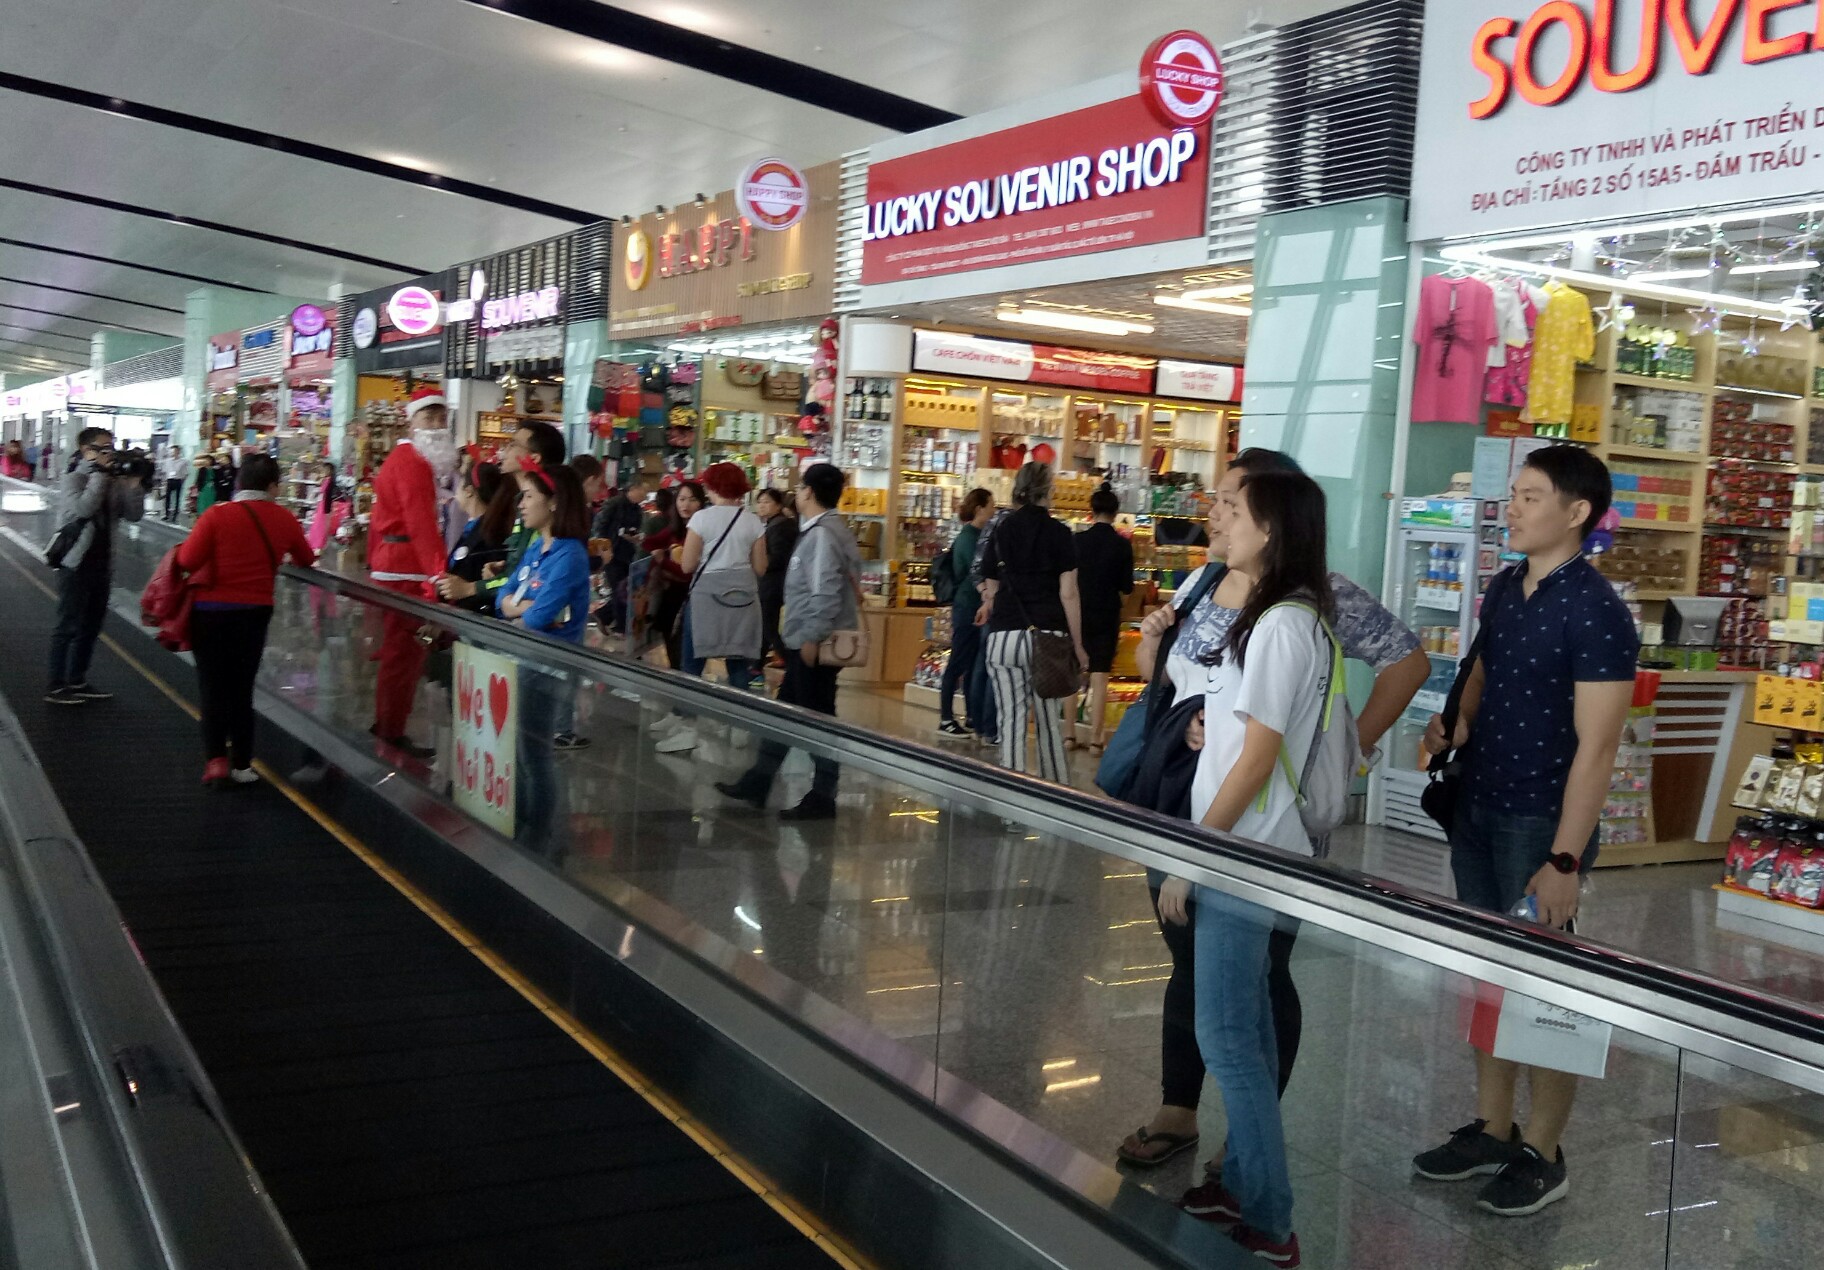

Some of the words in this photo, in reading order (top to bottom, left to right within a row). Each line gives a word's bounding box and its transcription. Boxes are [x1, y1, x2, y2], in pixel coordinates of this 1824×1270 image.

[1155, 68, 1190, 83] LUCKY
[1189, 74, 1220, 88] SHOP
[1468, 0, 1824, 120] SOUVE
[1571, 146, 1593, 167] TY
[1596, 137, 1646, 163] TNHH
[1651, 127, 1677, 153] VÀ
[1682, 118, 1737, 149] PHÁT
[861, 189, 943, 241] LUCKY
[944, 155, 1092, 225] SOUVENIR
[1097, 130, 1196, 196] SHOP
[1592, 176, 1602, 196] 2
[457, 660, 484, 731] We
